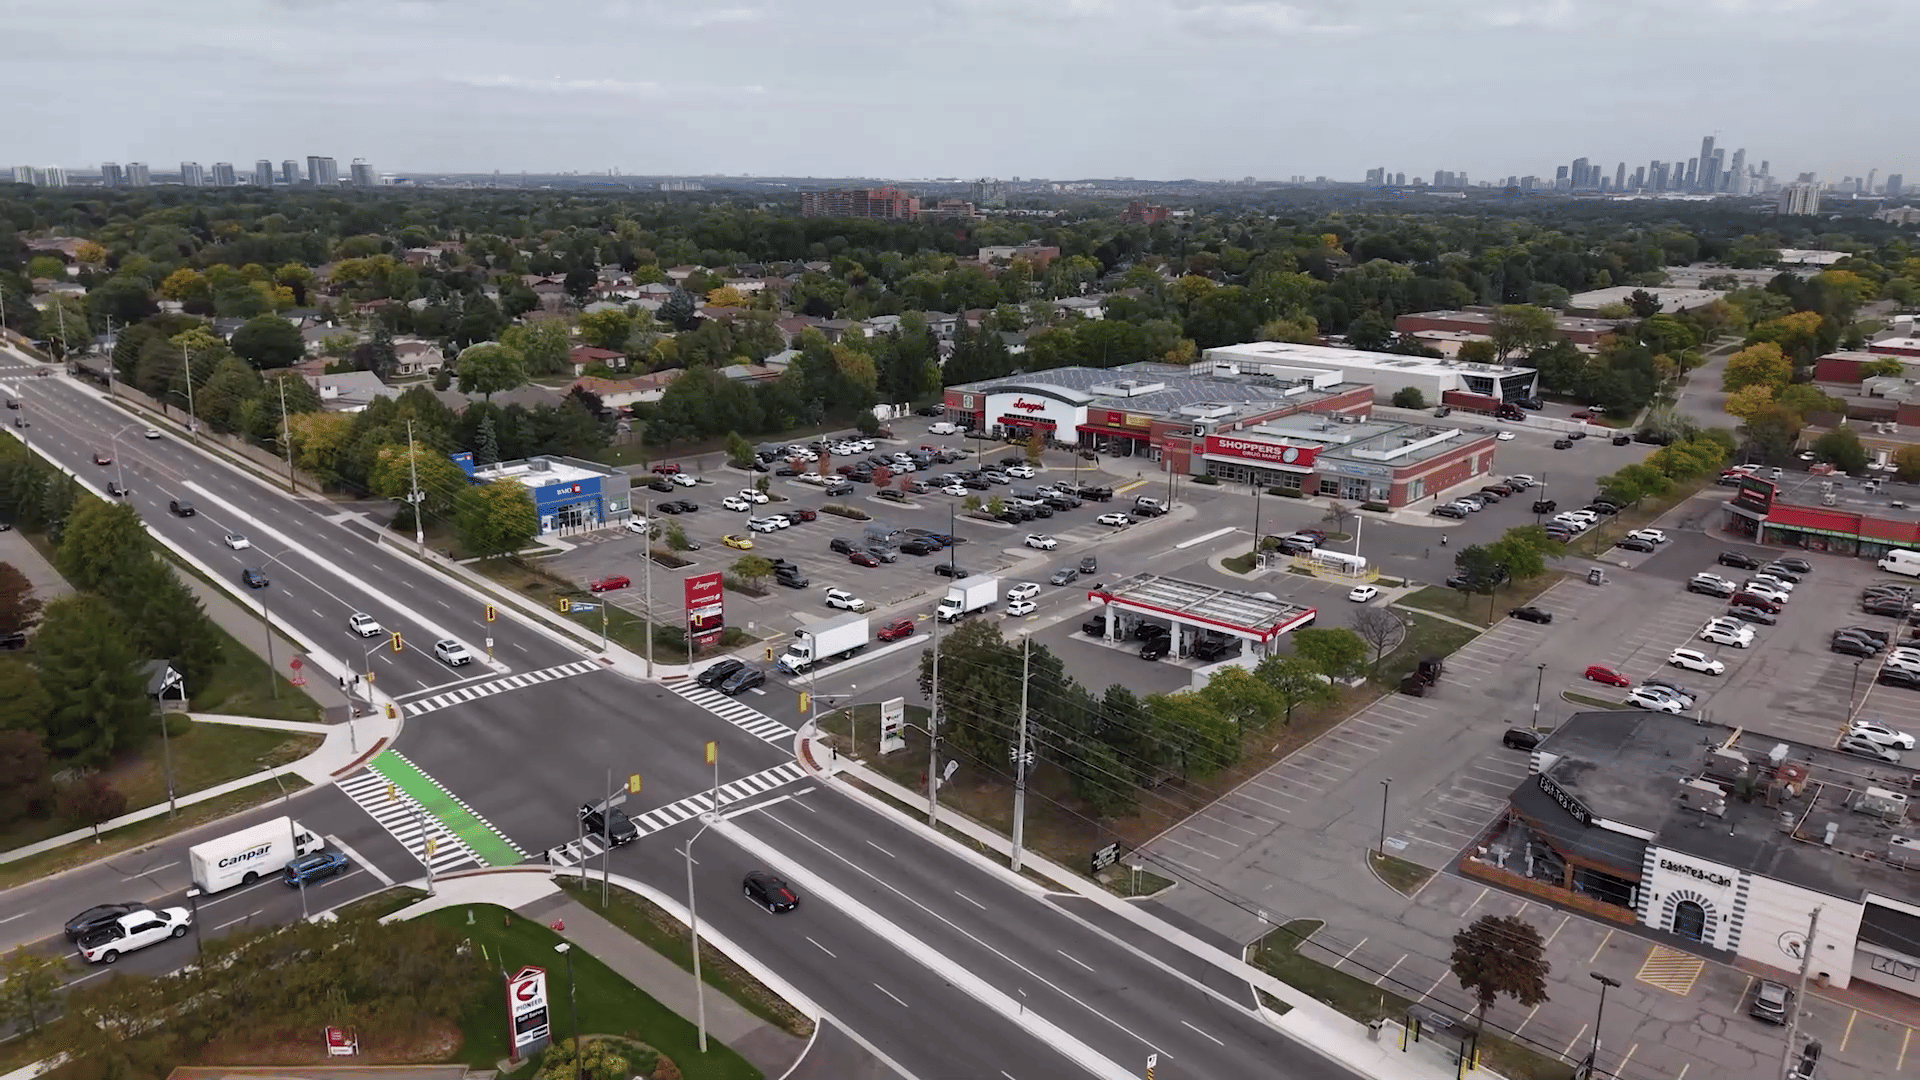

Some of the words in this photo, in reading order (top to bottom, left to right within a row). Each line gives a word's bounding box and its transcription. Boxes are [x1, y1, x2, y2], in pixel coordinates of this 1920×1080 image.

[1218, 439, 1282, 455] SHOPPERS
[1242, 450, 1261, 458] DRUG
[1261, 453, 1282, 461] MART
[556, 487, 572, 496] BMO
[218, 844, 272, 868] Canpar
[516, 997, 543, 1013] PIONEER
